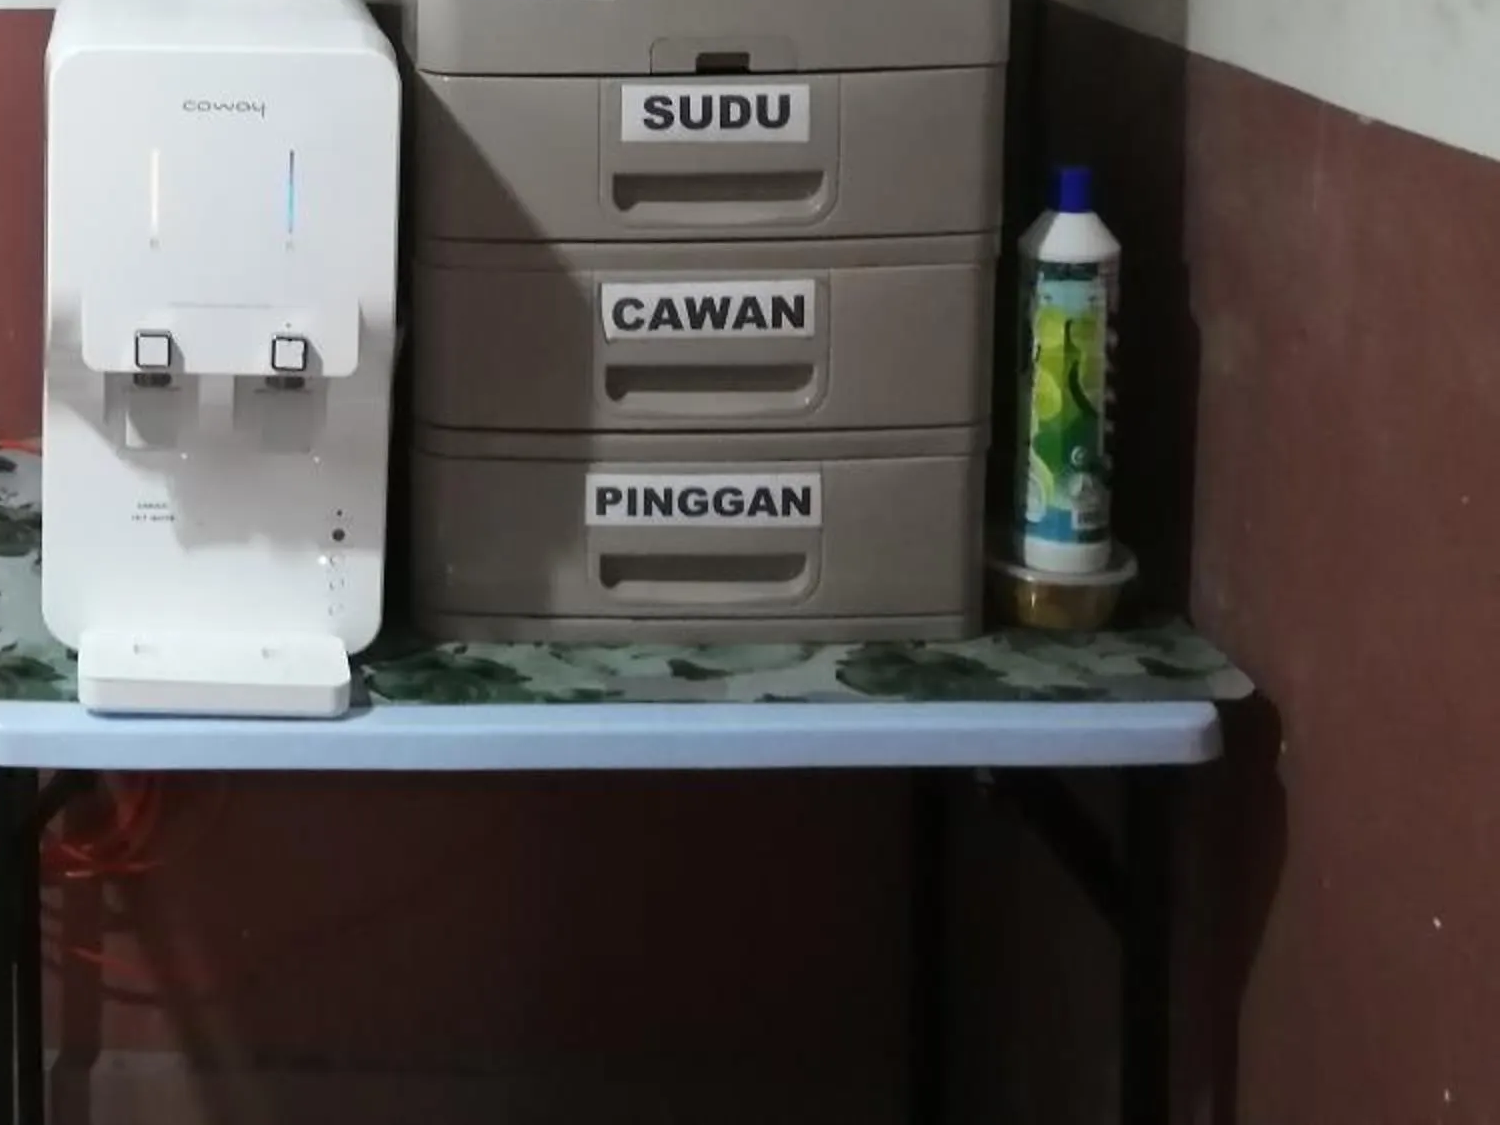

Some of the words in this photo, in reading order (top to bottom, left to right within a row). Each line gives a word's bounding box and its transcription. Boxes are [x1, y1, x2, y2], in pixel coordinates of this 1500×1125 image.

[643, 94, 791, 130] SUDU
[612, 295, 805, 331] CAWAN
[596, 486, 811, 517] PINGGAN
